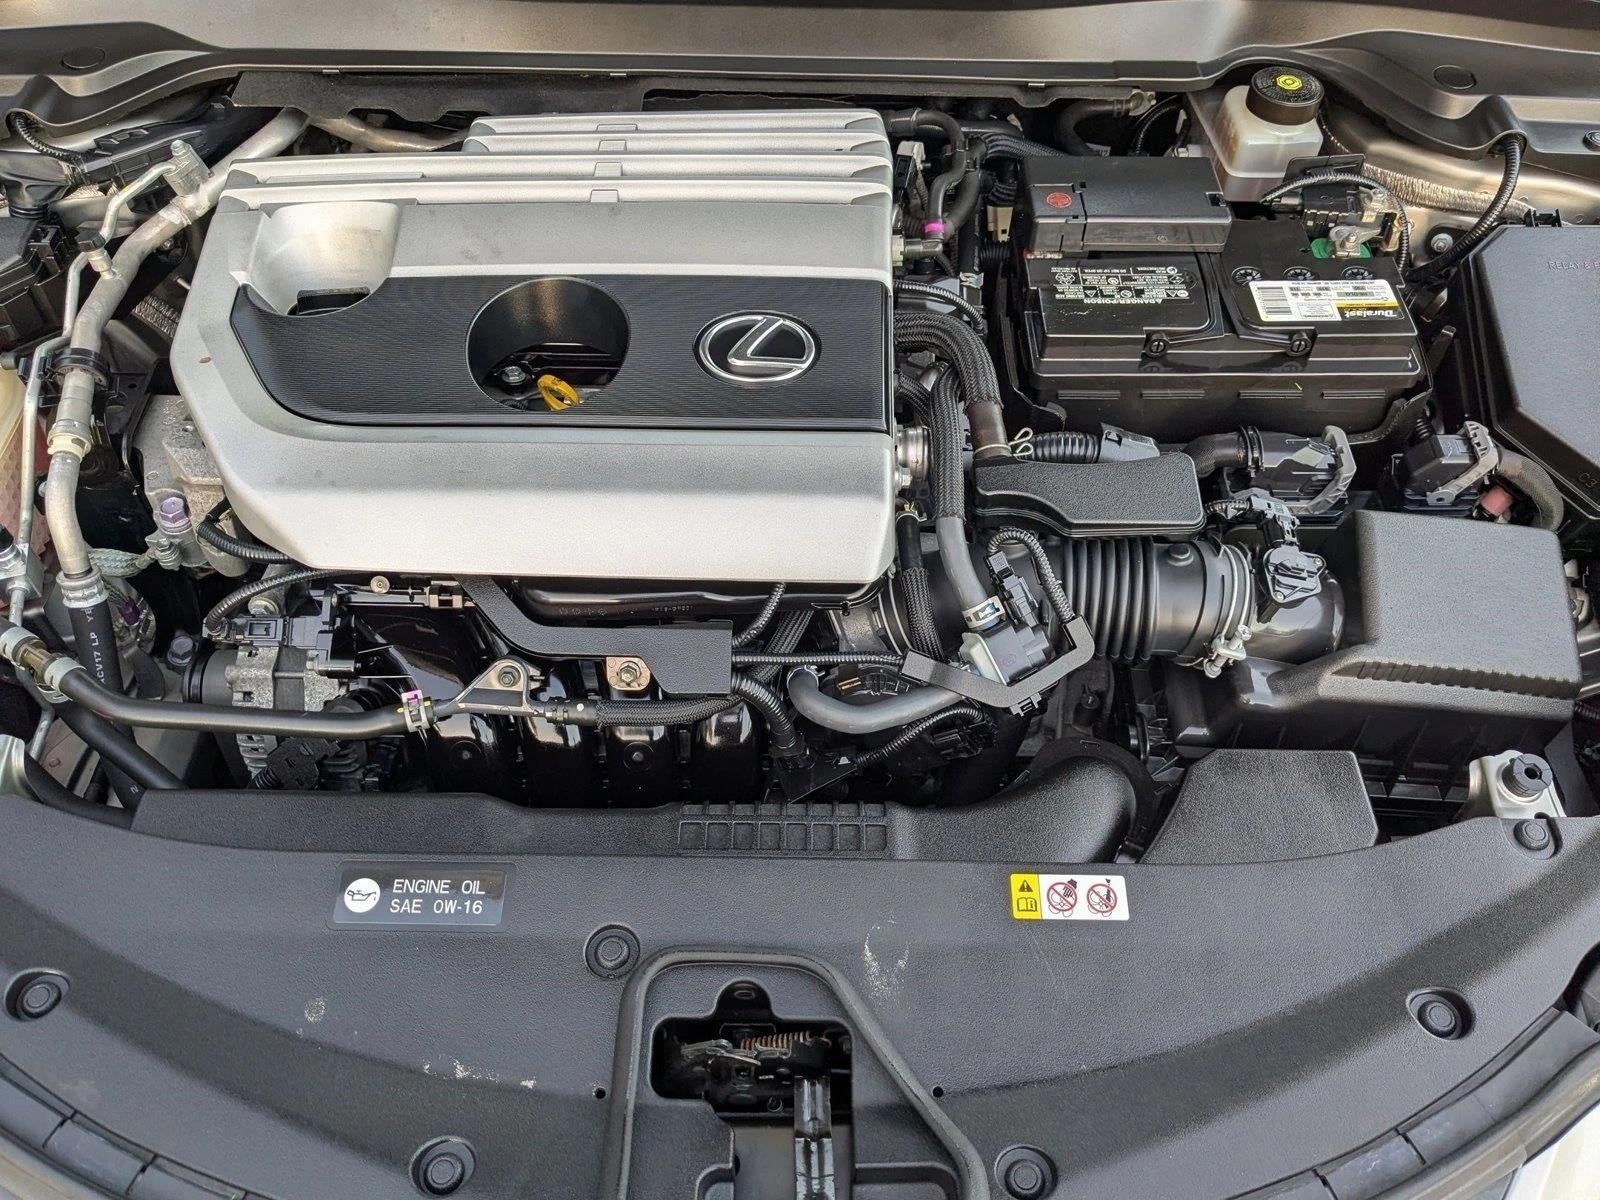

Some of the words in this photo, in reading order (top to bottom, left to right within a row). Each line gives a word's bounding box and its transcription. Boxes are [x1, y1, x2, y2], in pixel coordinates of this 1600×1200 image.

[1344, 310, 1397, 318] Duralast
[89, 631, 99, 646] LP
[392, 878, 451, 894] ENGINE
[461, 880, 486, 895] OIL
[389, 898, 423, 914] SAE
